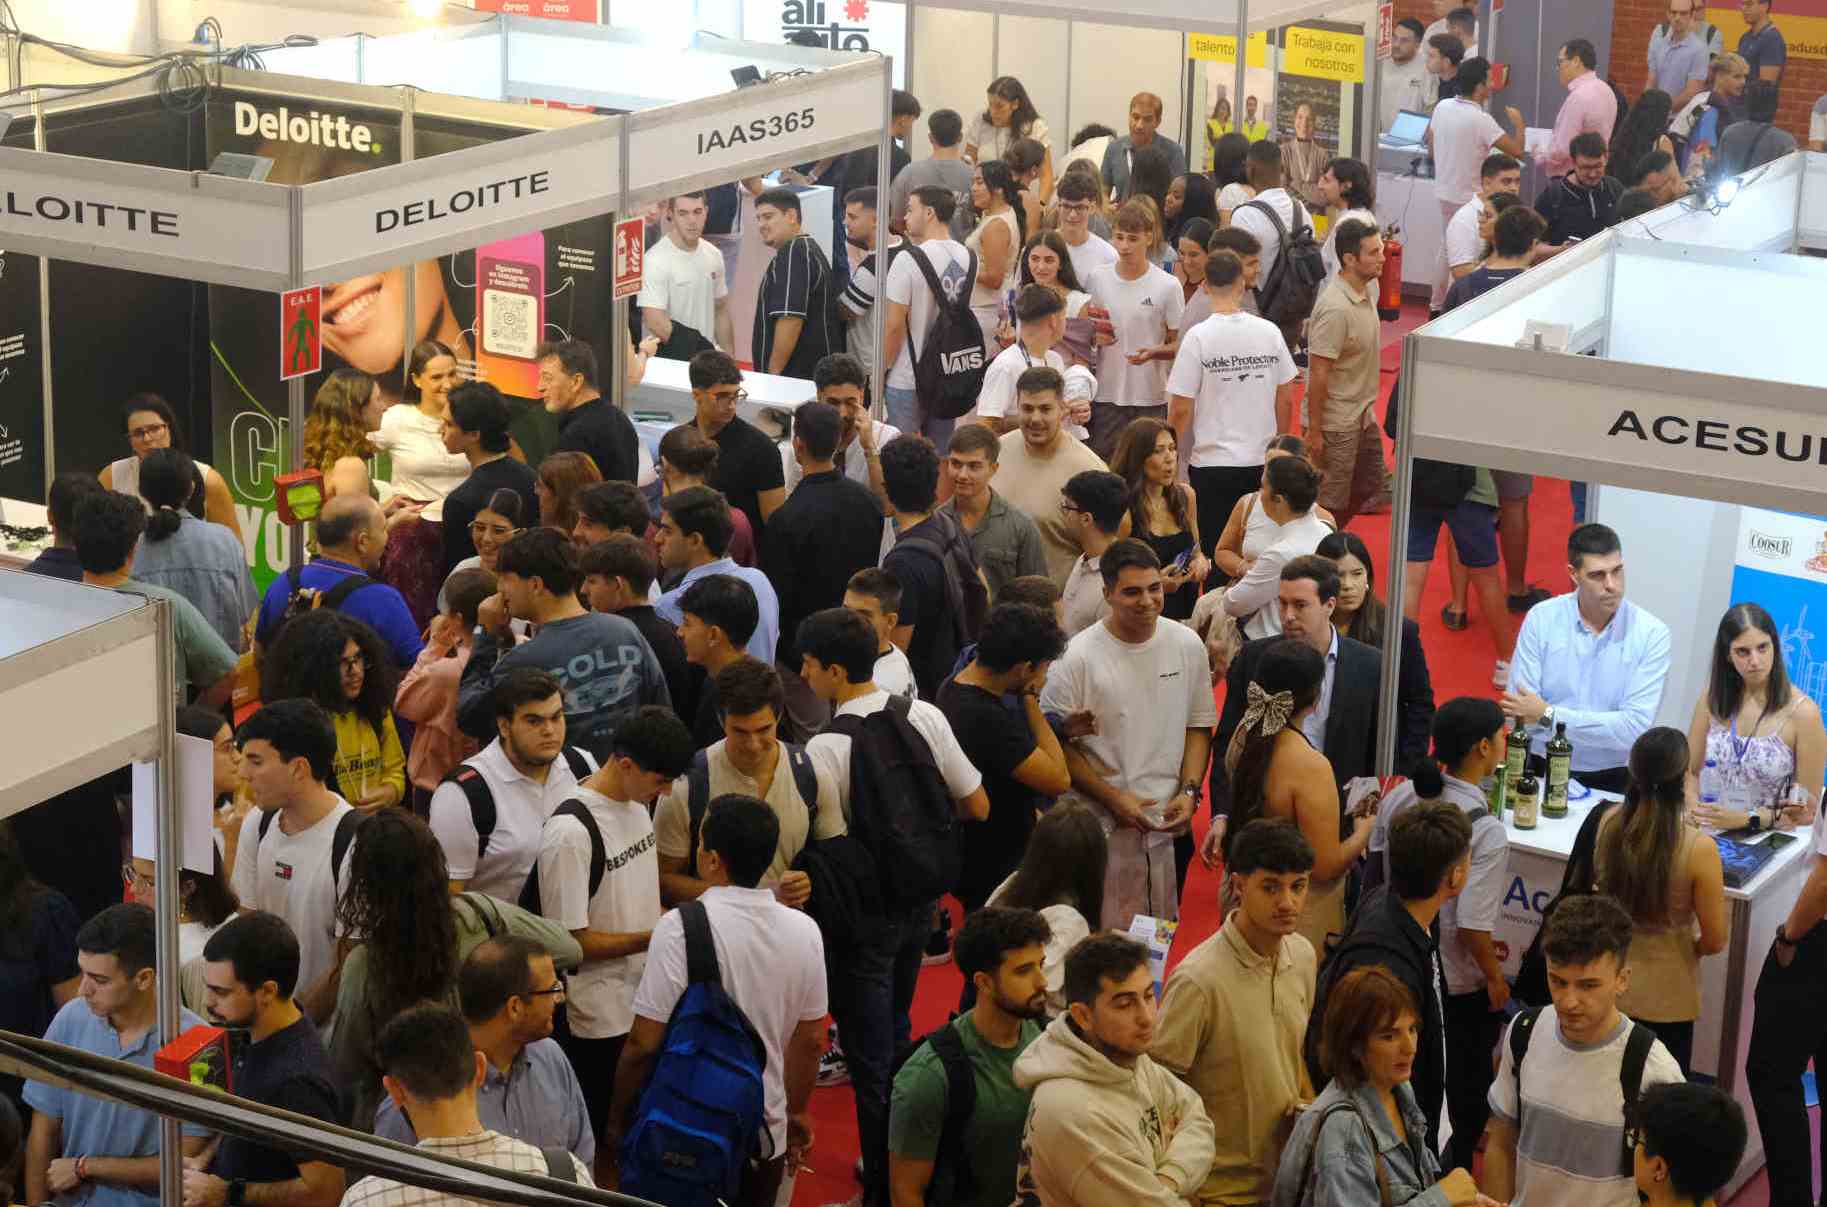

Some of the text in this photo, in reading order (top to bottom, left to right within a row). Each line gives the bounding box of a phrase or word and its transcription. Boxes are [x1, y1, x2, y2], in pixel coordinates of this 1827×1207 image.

[1293, 33, 1356, 54] Trabaja con
[1305, 57, 1355, 73] nosotros
[697, 107, 814, 154] IAAS365
[0, 192, 179, 237] LOITTE
[376, 170, 549, 233] DELOITTE
[940, 346, 983, 376] VANS
